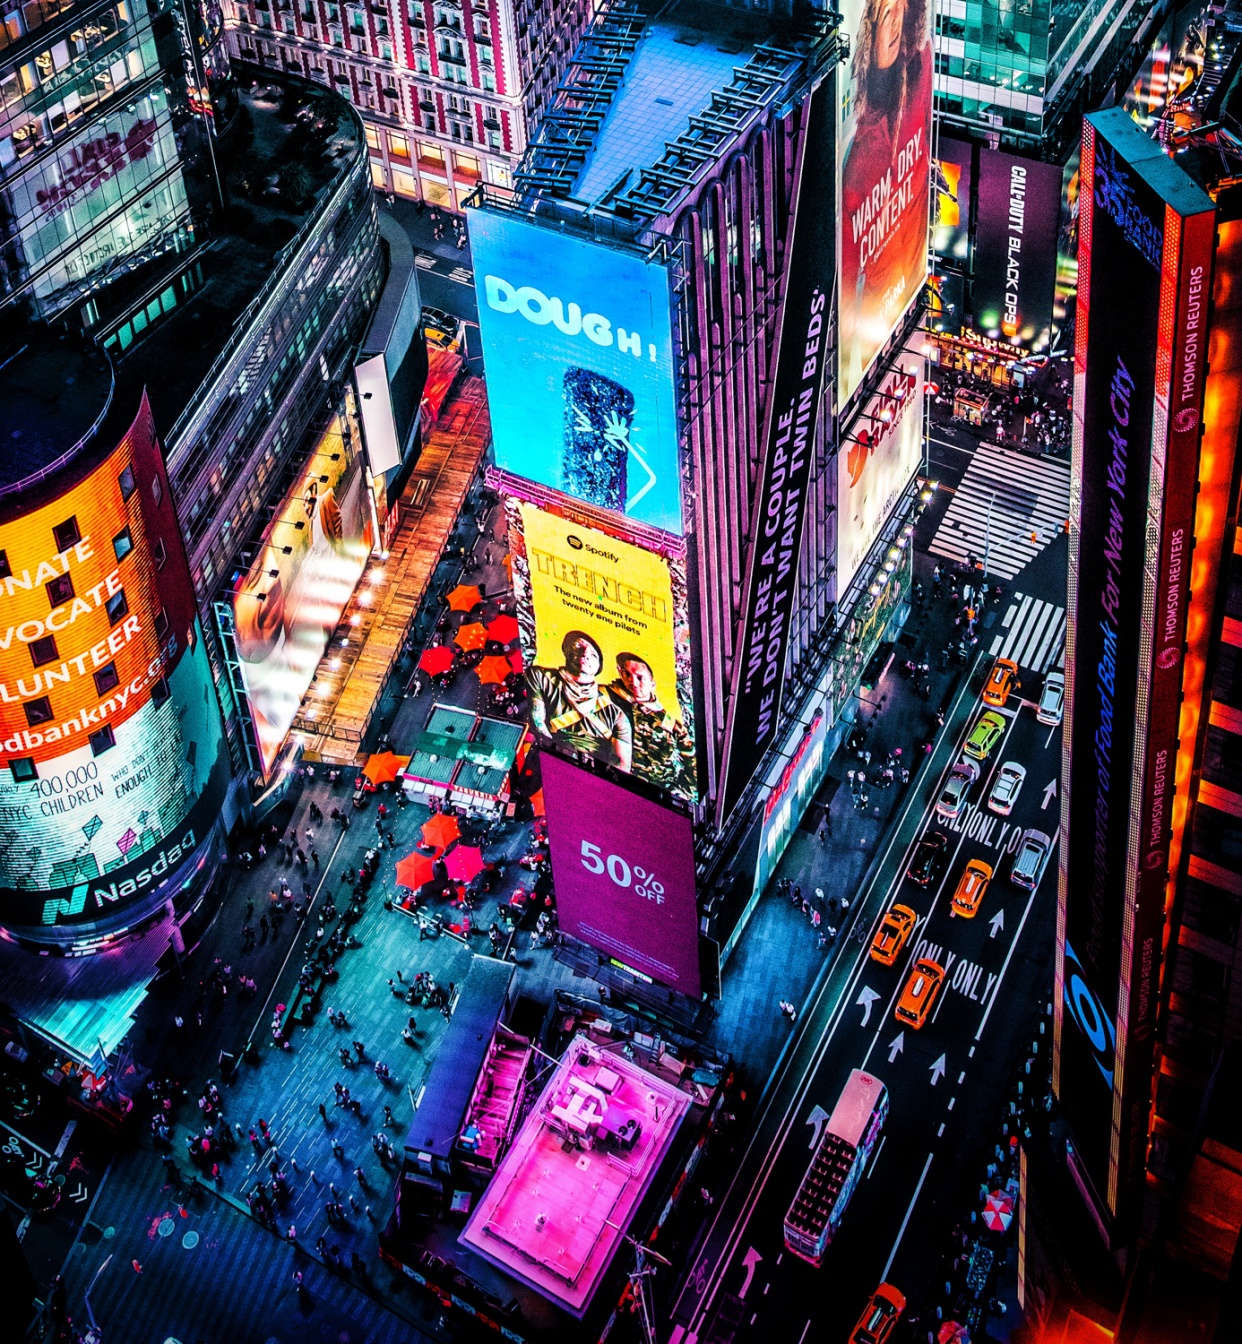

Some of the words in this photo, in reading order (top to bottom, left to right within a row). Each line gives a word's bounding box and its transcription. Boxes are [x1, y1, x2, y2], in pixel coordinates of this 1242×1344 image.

[852, 167, 894, 244] WARM.
[897, 127, 922, 183] DRY.
[860, 171, 914, 268] CONTENT.
[1006, 236, 1022, 291] BLACK
[1004, 292, 1018, 324] OPS
[1186, 266, 1203, 331] REUTERS
[1111, 354, 1135, 426] City
[1182, 332, 1198, 402] THOMSON
[789, 387, 814, 481] TWIN
[1107, 425, 1128, 500] York
[764, 397, 796, 539] COUPLE.
[585, 544, 619, 563] Spotify
[761, 541, 777, 565] A
[776, 487, 801, 585] WANT
[1103, 497, 1124, 575] New
[1169, 528, 1184, 583] REUTERS
[532, 547, 667, 623] TRENCH
[553, 584, 571, 597] The
[572, 593, 593, 607] new
[594, 601, 623, 619] album
[624, 613, 648, 630] from
[562, 598, 595, 618] twenty
[1101, 568, 1121, 626] For
[1164, 583, 1179, 642] THOMSON
[0, 615, 143, 704] LUNTEER
[762, 589, 788, 688] DON'T
[1098, 619, 1118, 690] Bank
[755, 688, 775, 746] WE
[1095, 681, 1116, 764] Food
[29, 761, 100, 800] 400,000
[111, 766, 130, 782] WHO
[1154, 749, 1167, 796] REUTERS
[1, 802, 34, 822] NYC
[40, 783, 105, 817] CHILDREN
[968, 812, 1011, 850] ONLY
[1150, 797, 1163, 847] THOMSON
[94, 828, 196, 908] Nasdaq
[581, 840, 665, 895] 50%
[635, 886, 665, 905] OFF
[952, 959, 998, 1005] ONLY
